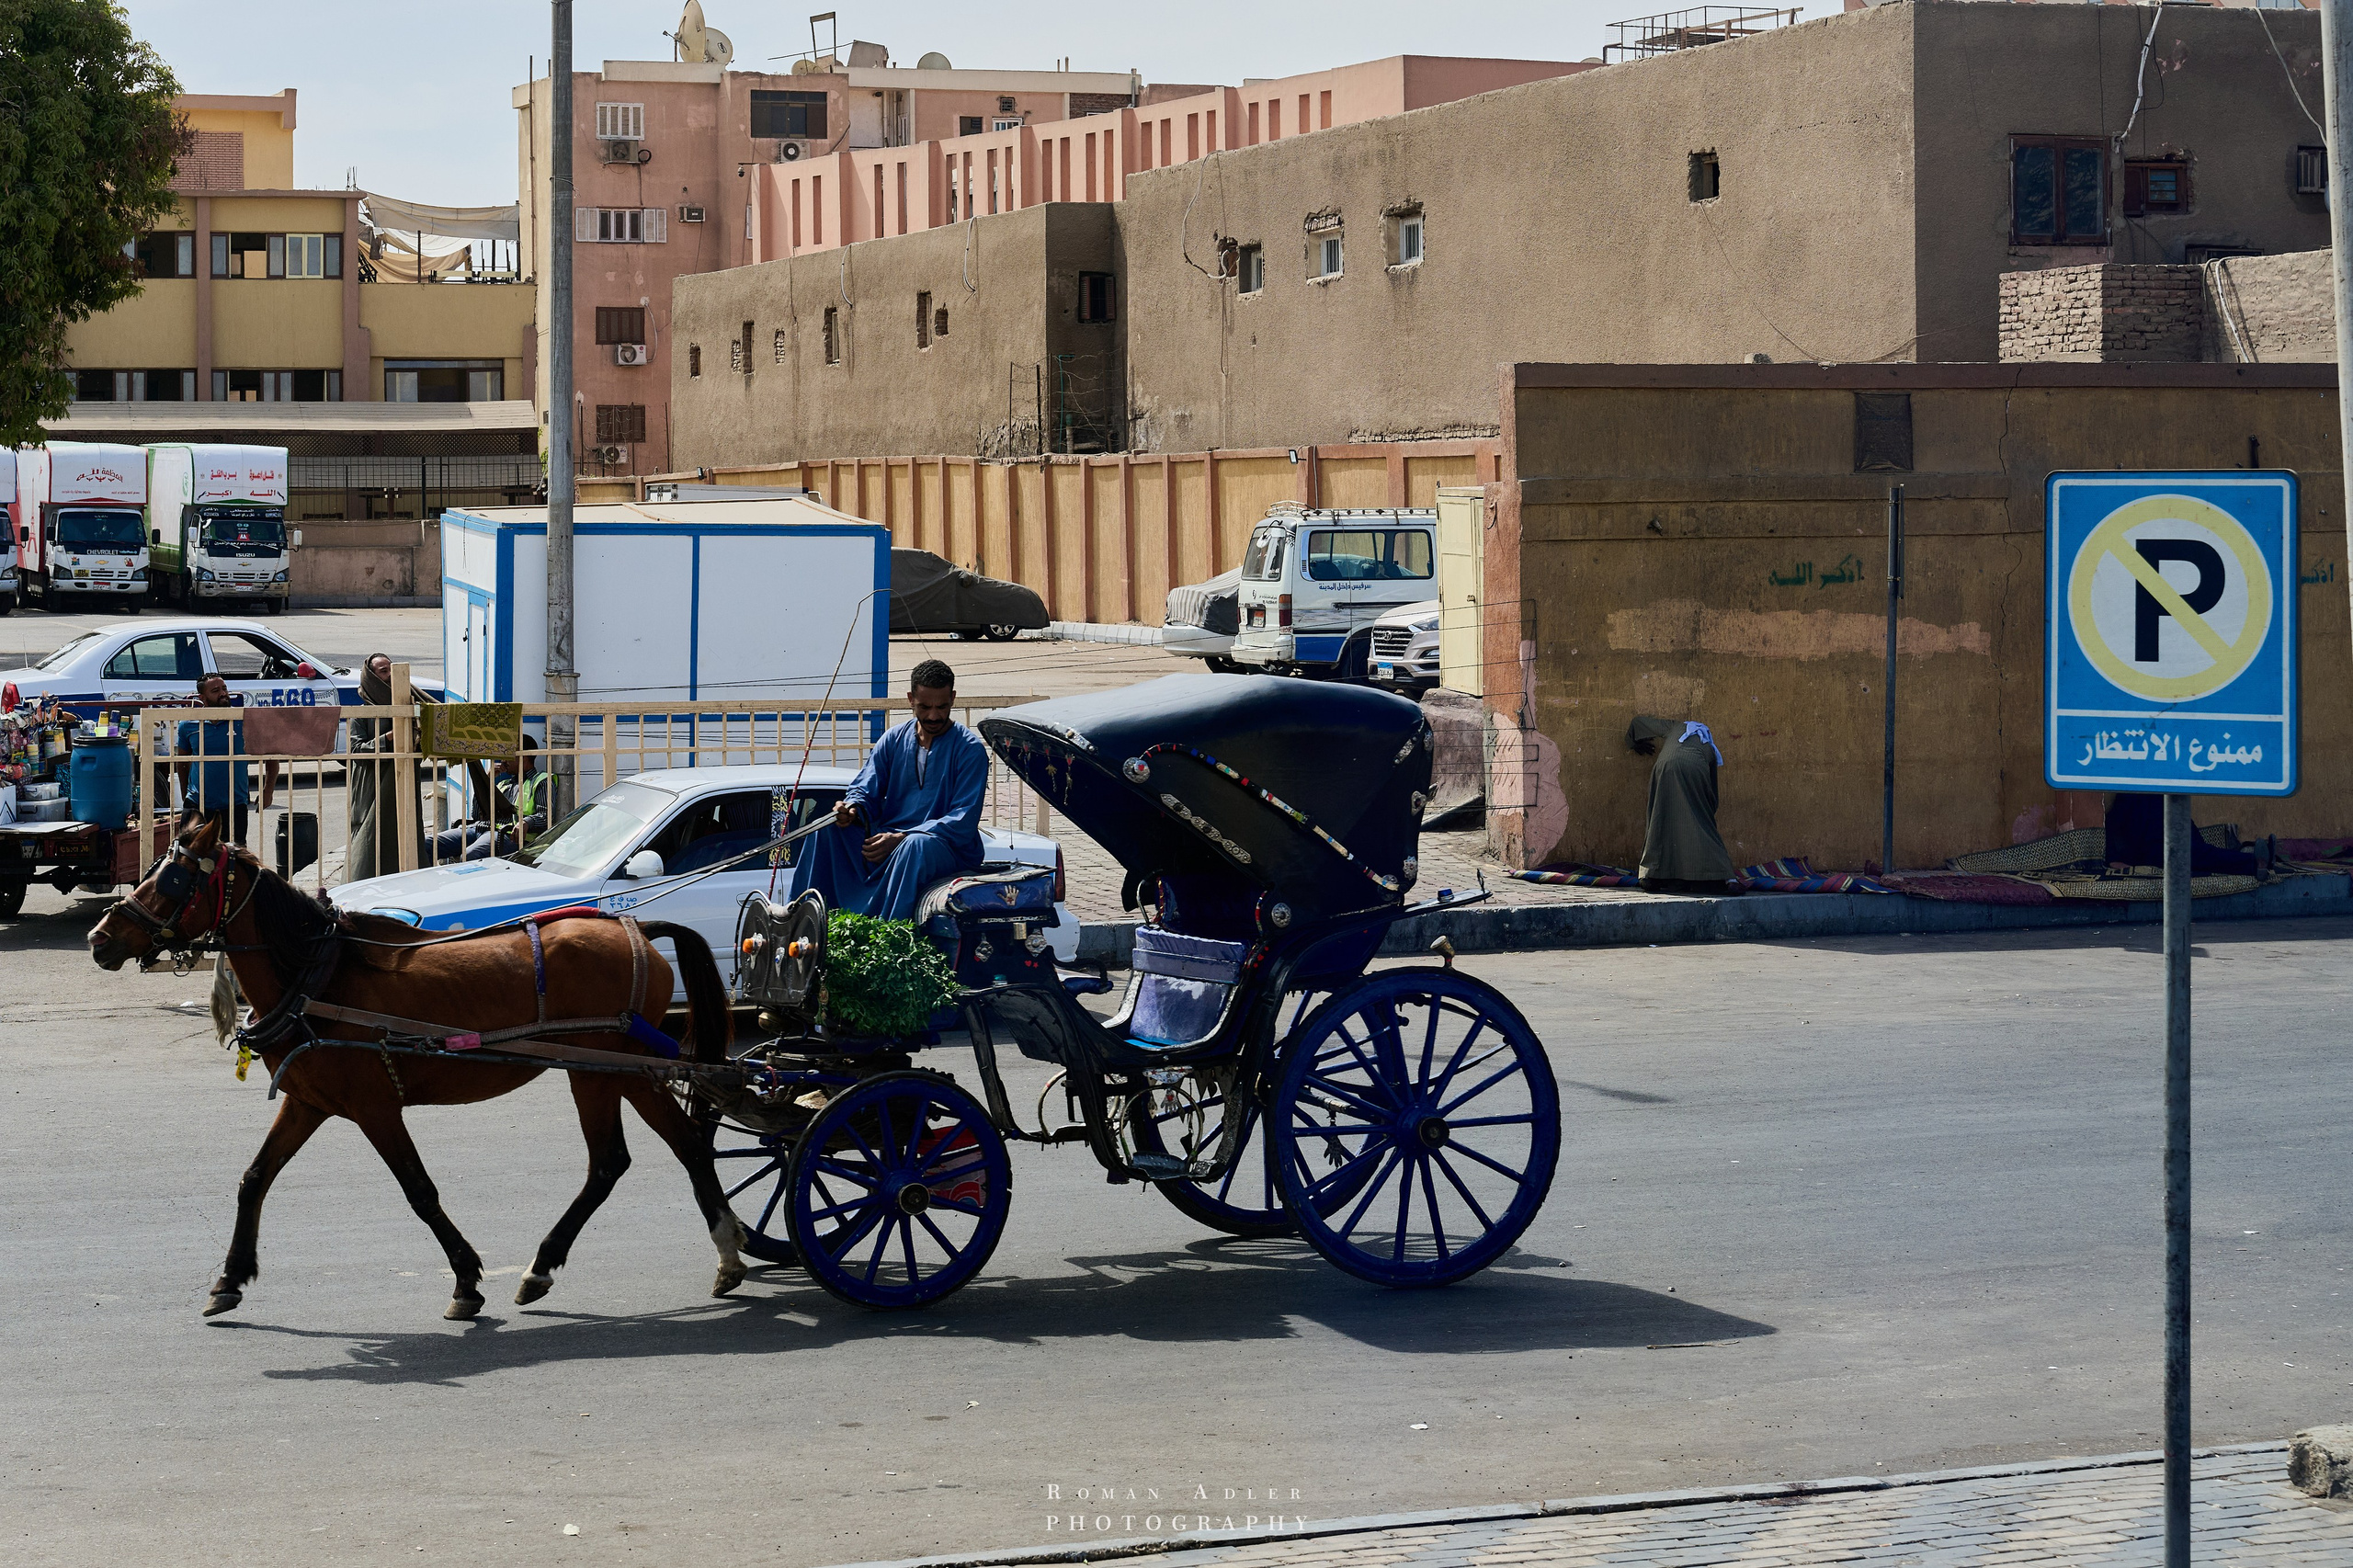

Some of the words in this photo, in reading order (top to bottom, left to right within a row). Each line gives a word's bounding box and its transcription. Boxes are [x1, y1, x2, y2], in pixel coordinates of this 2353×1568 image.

[249, 489, 277, 497] الله
[1768, 561, 1813, 587] الله
[1819, 553, 1865, 591] اذكر
[2301, 557, 2335, 585] اذك
[2134, 538, 2226, 663] P
[2076, 729, 2180, 766] الانتظار
[2188, 732, 2263, 772] ممنوع
